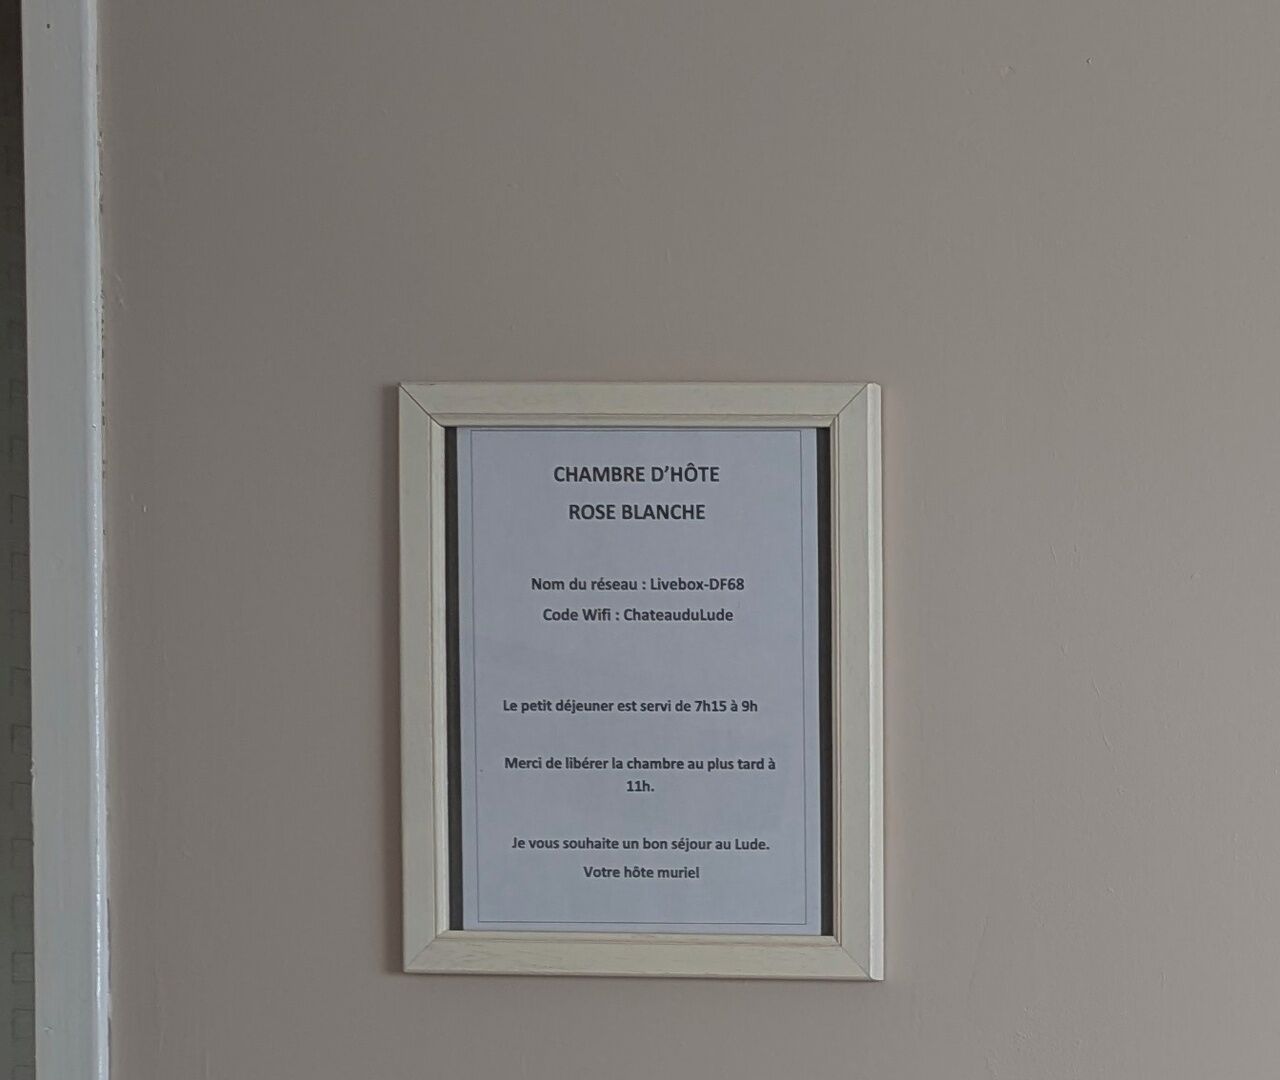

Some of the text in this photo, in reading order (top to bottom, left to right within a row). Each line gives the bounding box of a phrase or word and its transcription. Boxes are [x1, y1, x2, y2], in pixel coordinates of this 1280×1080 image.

[553, 467, 646, 483] CHAMBRE
[568, 504, 706, 521] ROSE BLANCHE
[531, 578, 565, 591] Nom
[568, 577, 587, 591] du
[590, 577, 639, 591] réseau
[650, 577, 745, 591] Livebox-DF68
[542, 608, 579, 622] Code
[581, 608, 612, 622] Wifi
[623, 608, 734, 622] ChateauduLude
[502, 699, 758, 715] Le petit déjeuner est servi de 7h15 à 9h
[504, 757, 777, 773] Merci de libérer la chambre au plus tard à
[626, 780, 655, 793] 11h.
[511, 837, 771, 853] Je vous souhaite un bon séjour au Lude.
[582, 866, 700, 879] Votre hôte muriel
